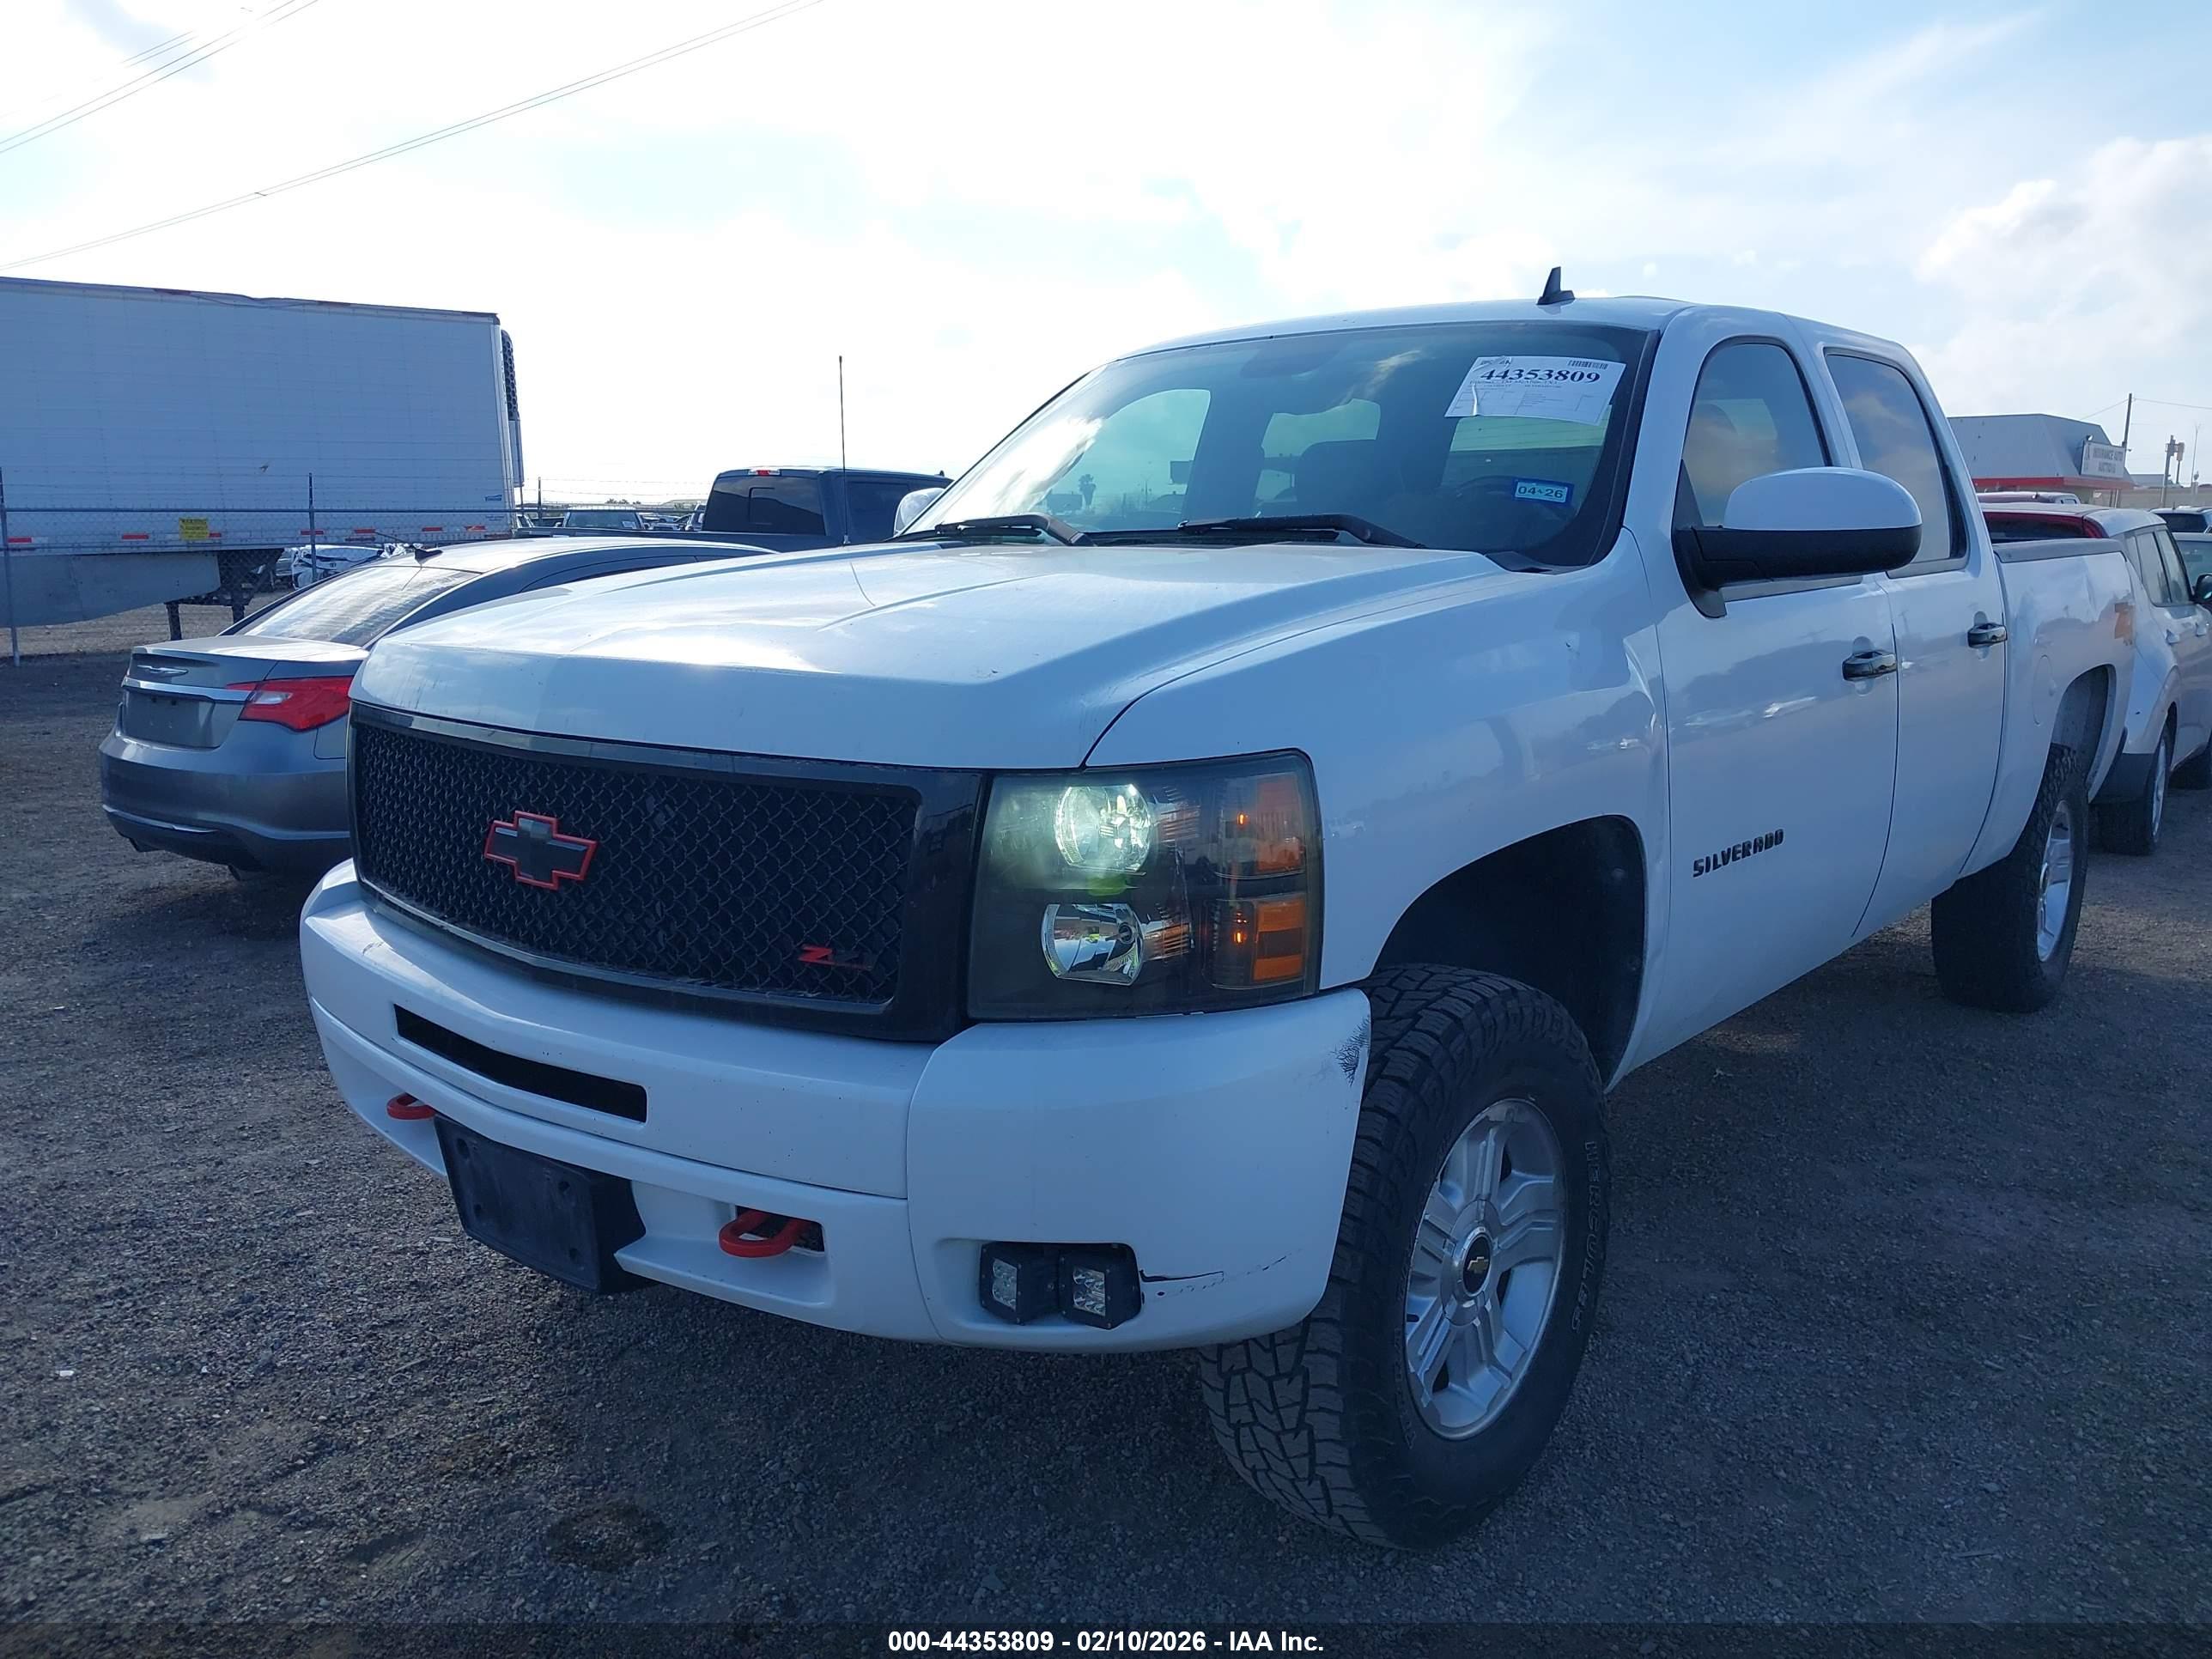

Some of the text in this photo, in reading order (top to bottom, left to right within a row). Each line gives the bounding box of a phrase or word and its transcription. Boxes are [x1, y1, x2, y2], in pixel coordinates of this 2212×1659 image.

[1480, 368, 1601, 384] 44353809
[1692, 828, 1784, 878] SILVERADO
[1571, 1140, 1601, 1333] HERCULES
